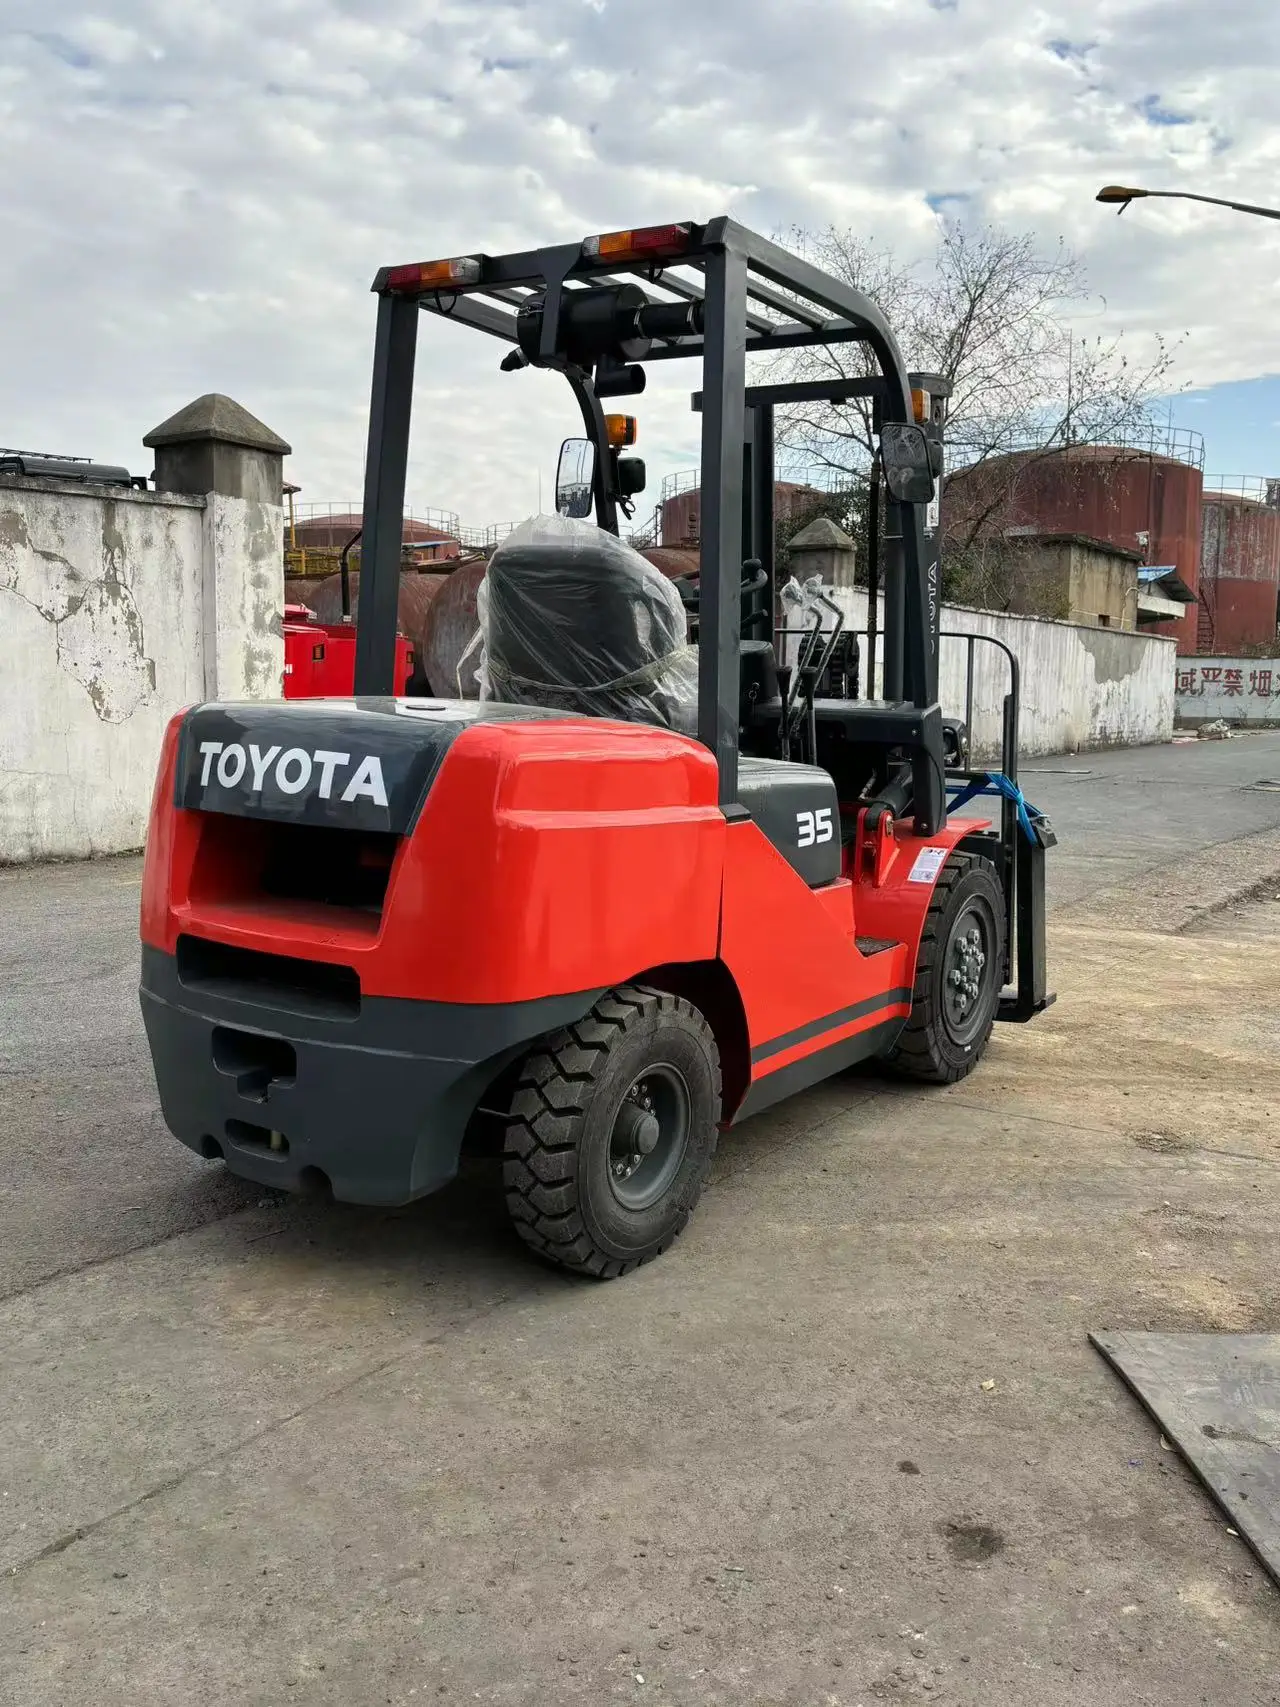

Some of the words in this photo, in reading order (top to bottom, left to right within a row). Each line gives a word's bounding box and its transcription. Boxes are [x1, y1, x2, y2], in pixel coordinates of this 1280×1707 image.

[1174, 667, 1280, 697] 域严禁烟
[199, 741, 389, 807] TOYOTA
[796, 808, 833, 848] 35
